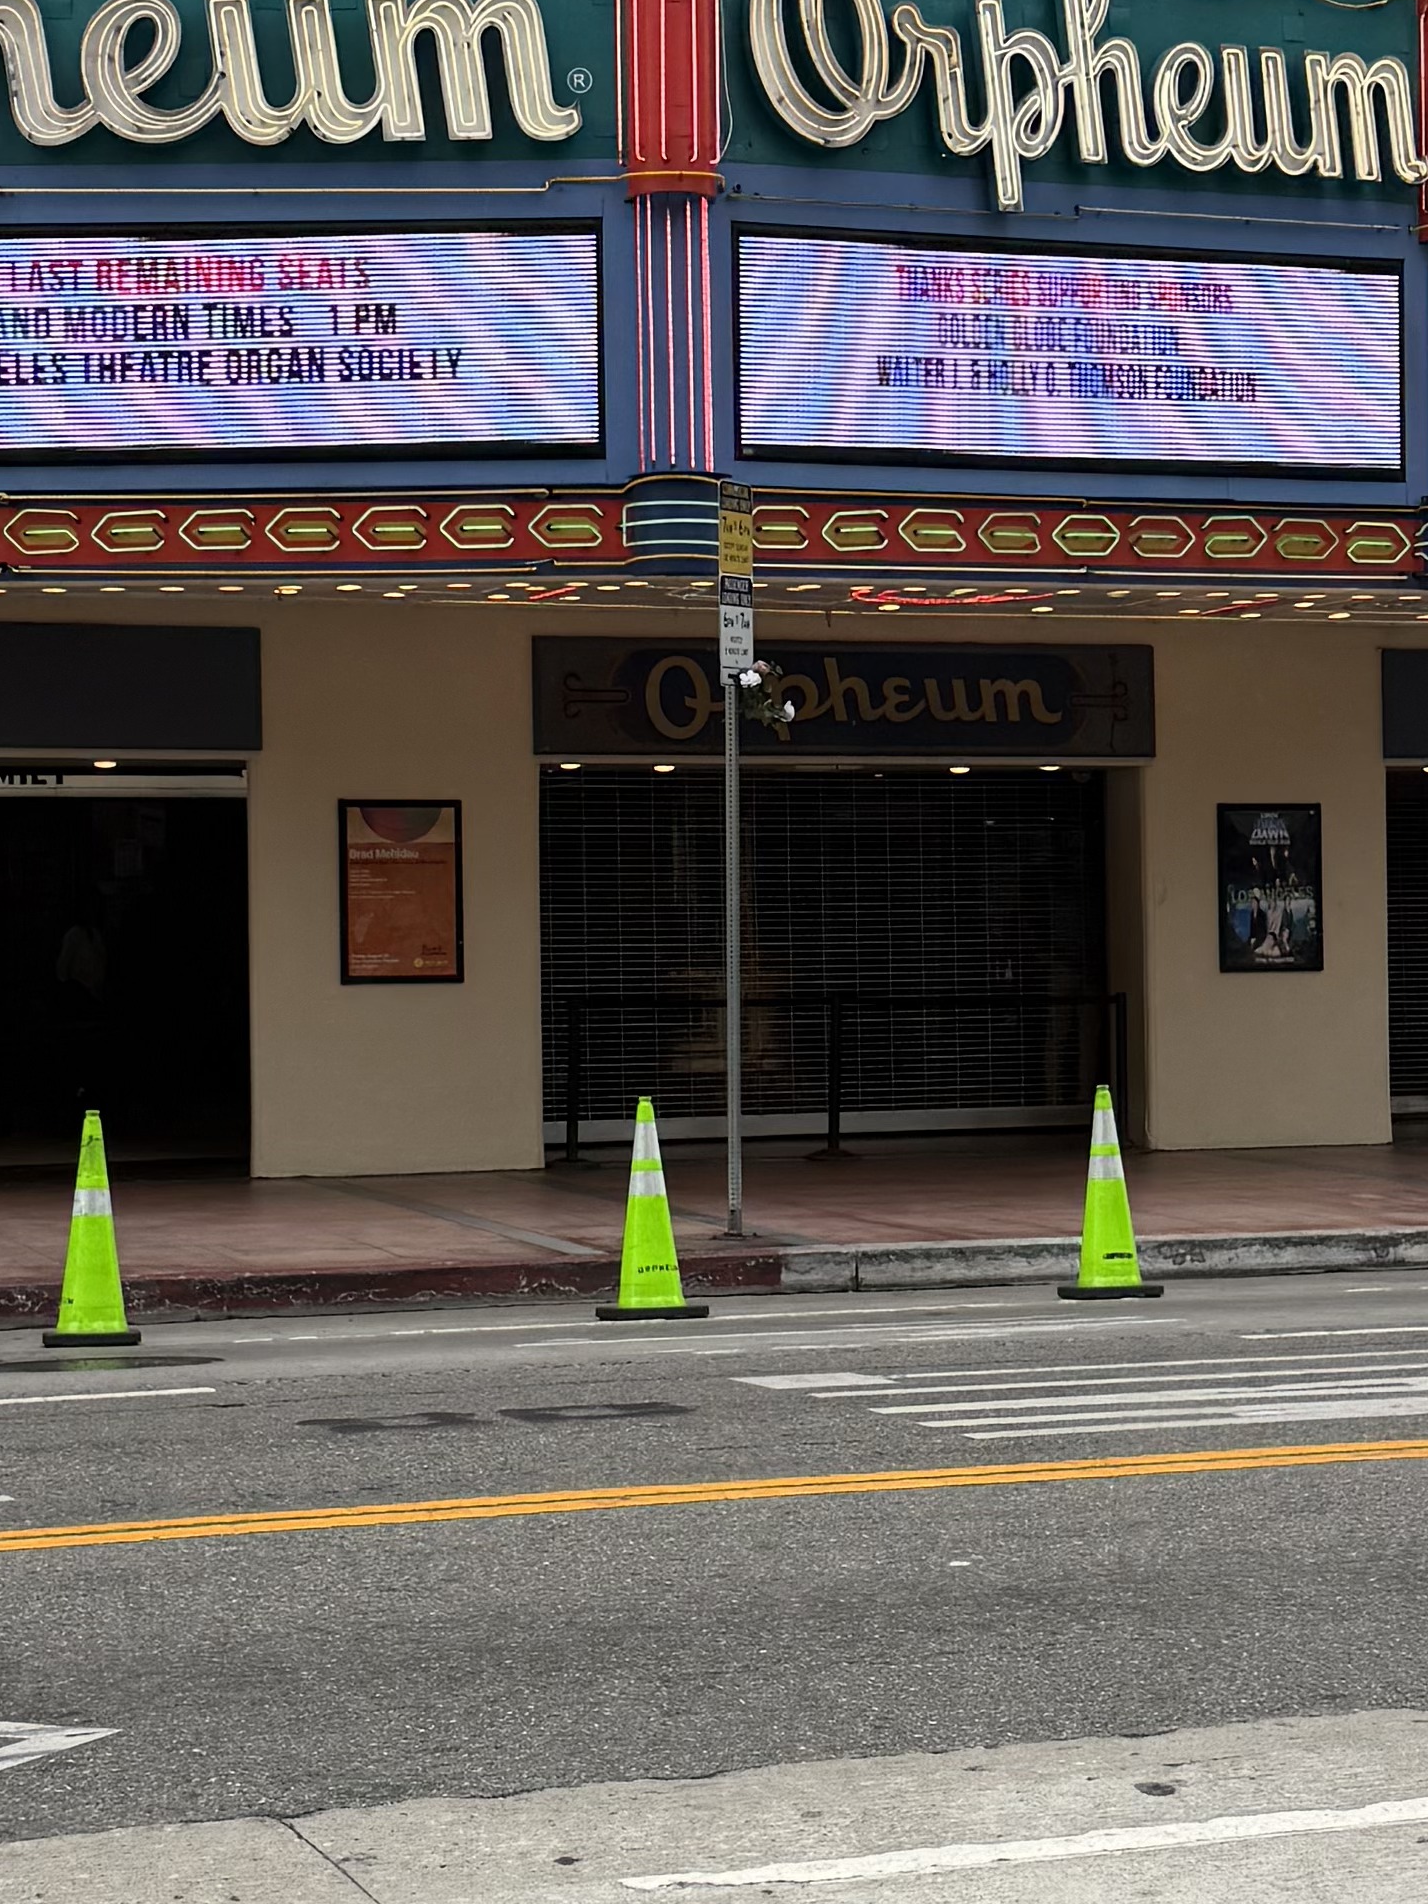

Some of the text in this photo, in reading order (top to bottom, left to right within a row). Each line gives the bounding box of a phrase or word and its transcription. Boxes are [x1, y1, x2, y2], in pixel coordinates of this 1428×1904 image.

[10, 258, 83, 293] LAST
[96, 256, 265, 294] REMAINING
[277, 255, 371, 291] SEATS
[63, 302, 190, 342] MODERN
[203, 301, 294, 339] TIMES
[354, 302, 398, 336] PM
[81, 348, 210, 386] THEATRE
[226, 347, 325, 386] ORGAN
[338, 345, 464, 383] SOCIETY
[644, 655, 1063, 742] Opheum
